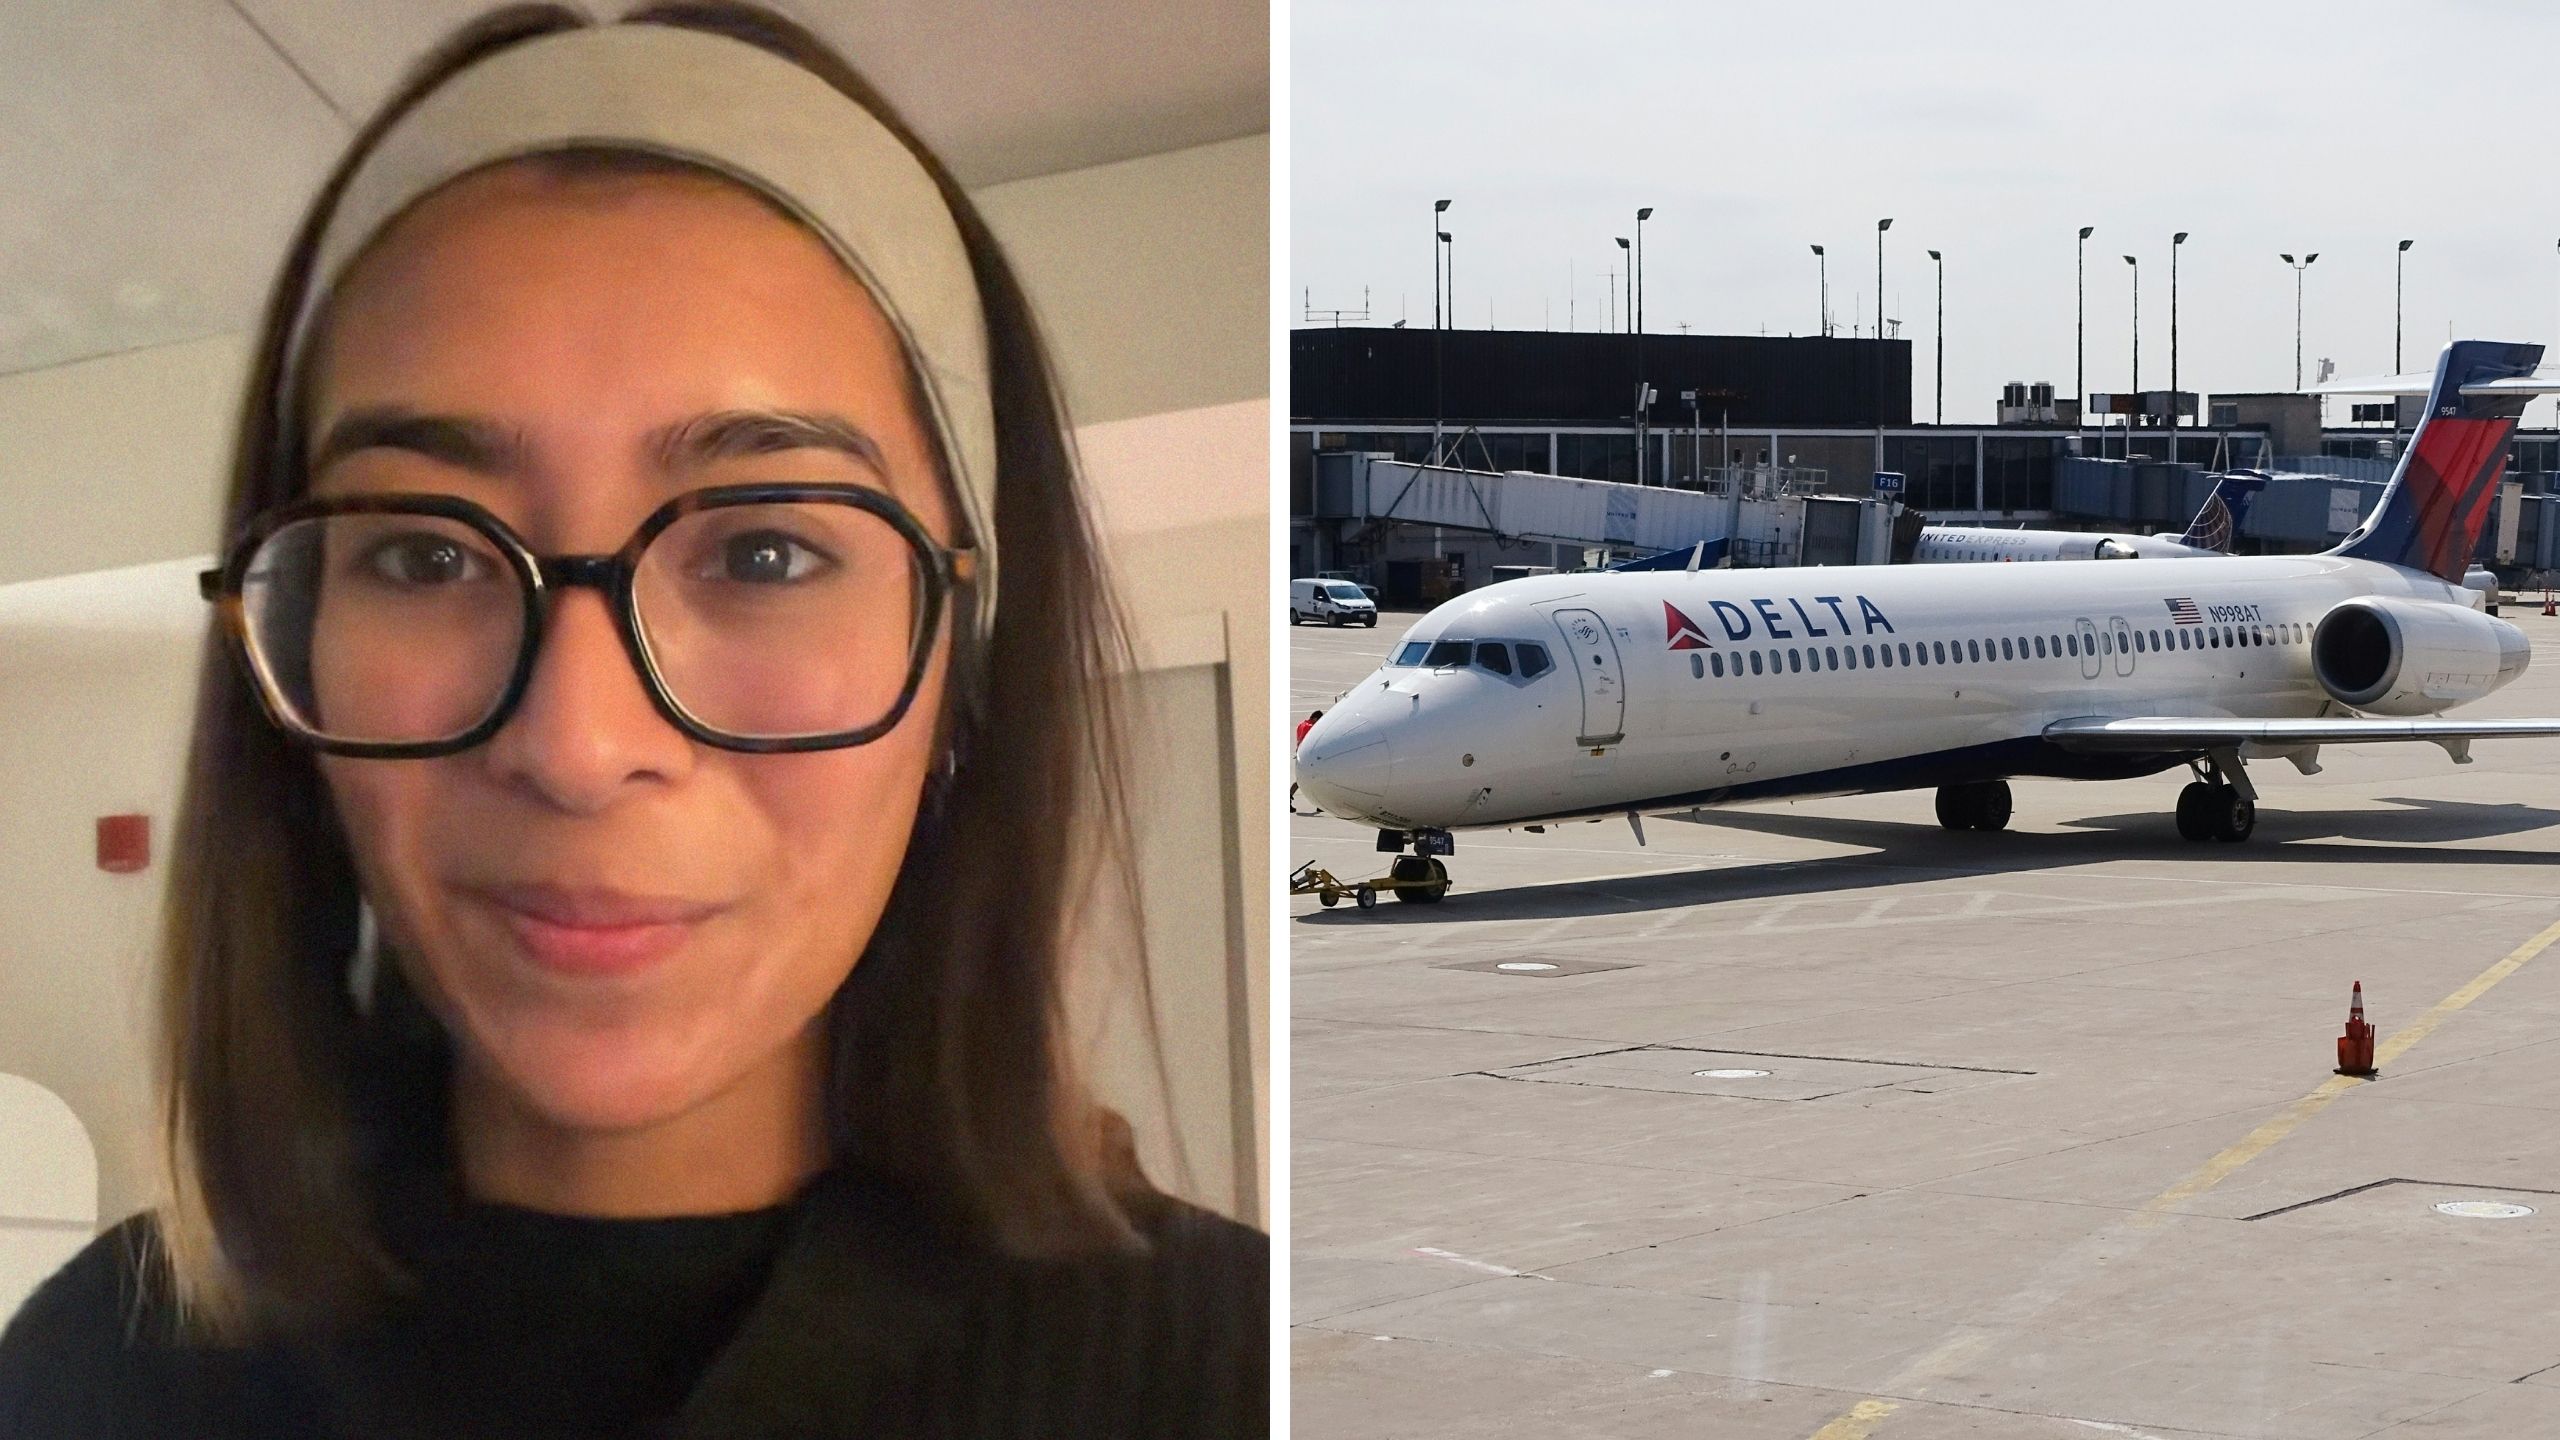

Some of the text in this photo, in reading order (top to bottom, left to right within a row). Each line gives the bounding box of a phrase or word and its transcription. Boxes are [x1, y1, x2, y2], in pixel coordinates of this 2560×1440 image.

[1879, 477, 1898, 488] F16
[1708, 595, 1895, 641] DELTA
[2207, 604, 2261, 623] N998AT
